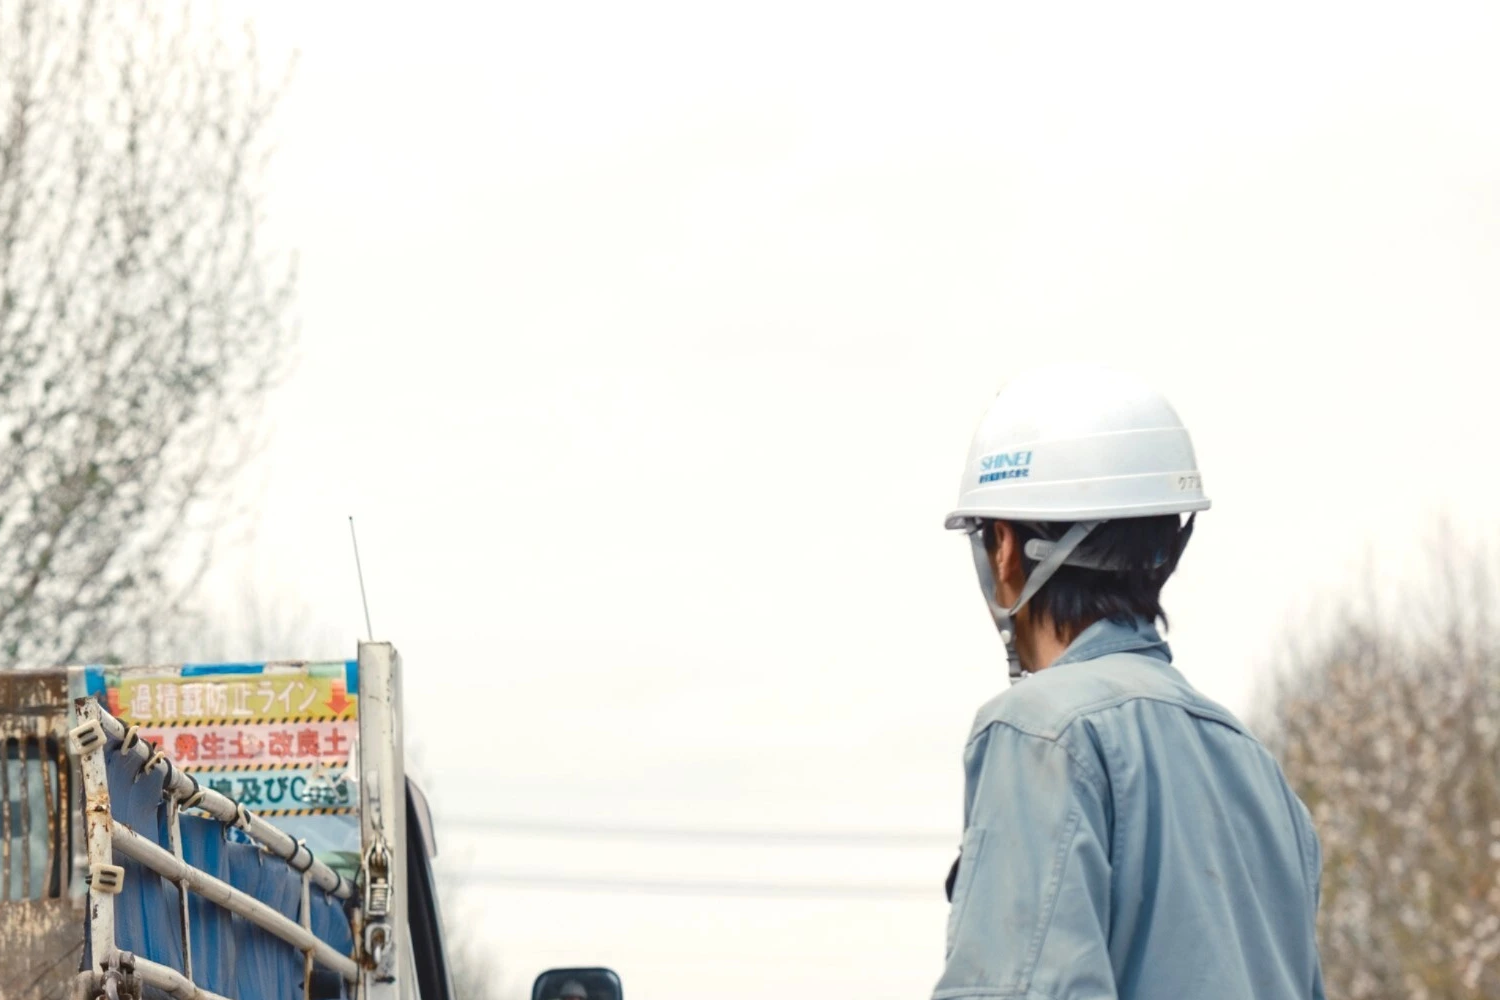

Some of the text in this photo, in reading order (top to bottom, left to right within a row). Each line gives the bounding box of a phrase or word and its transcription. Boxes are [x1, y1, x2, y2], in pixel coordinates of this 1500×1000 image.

[129, 680, 318, 719] 過積載防止ライン
